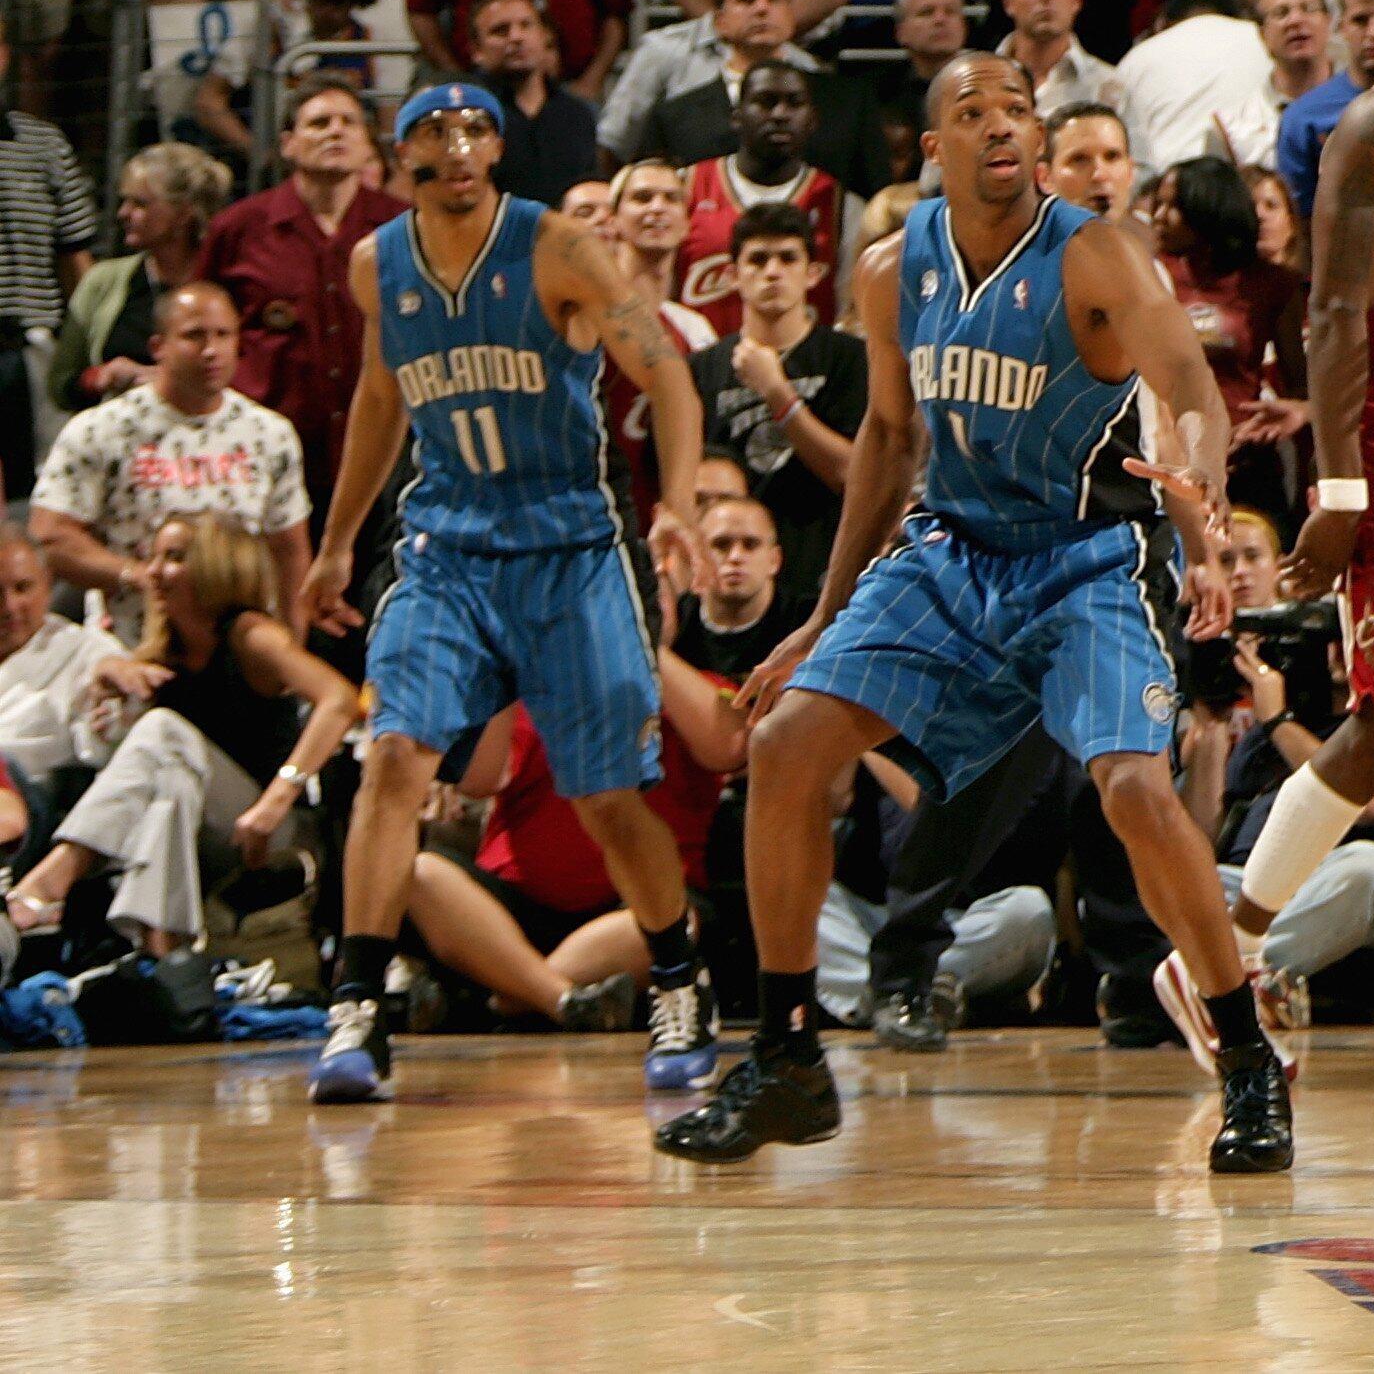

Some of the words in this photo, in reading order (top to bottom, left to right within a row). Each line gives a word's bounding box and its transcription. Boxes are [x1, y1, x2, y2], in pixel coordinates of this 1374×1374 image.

[396, 344, 547, 409] ORLANDO
[908, 342, 1049, 412] RLANDO
[451, 404, 508, 476] 11
